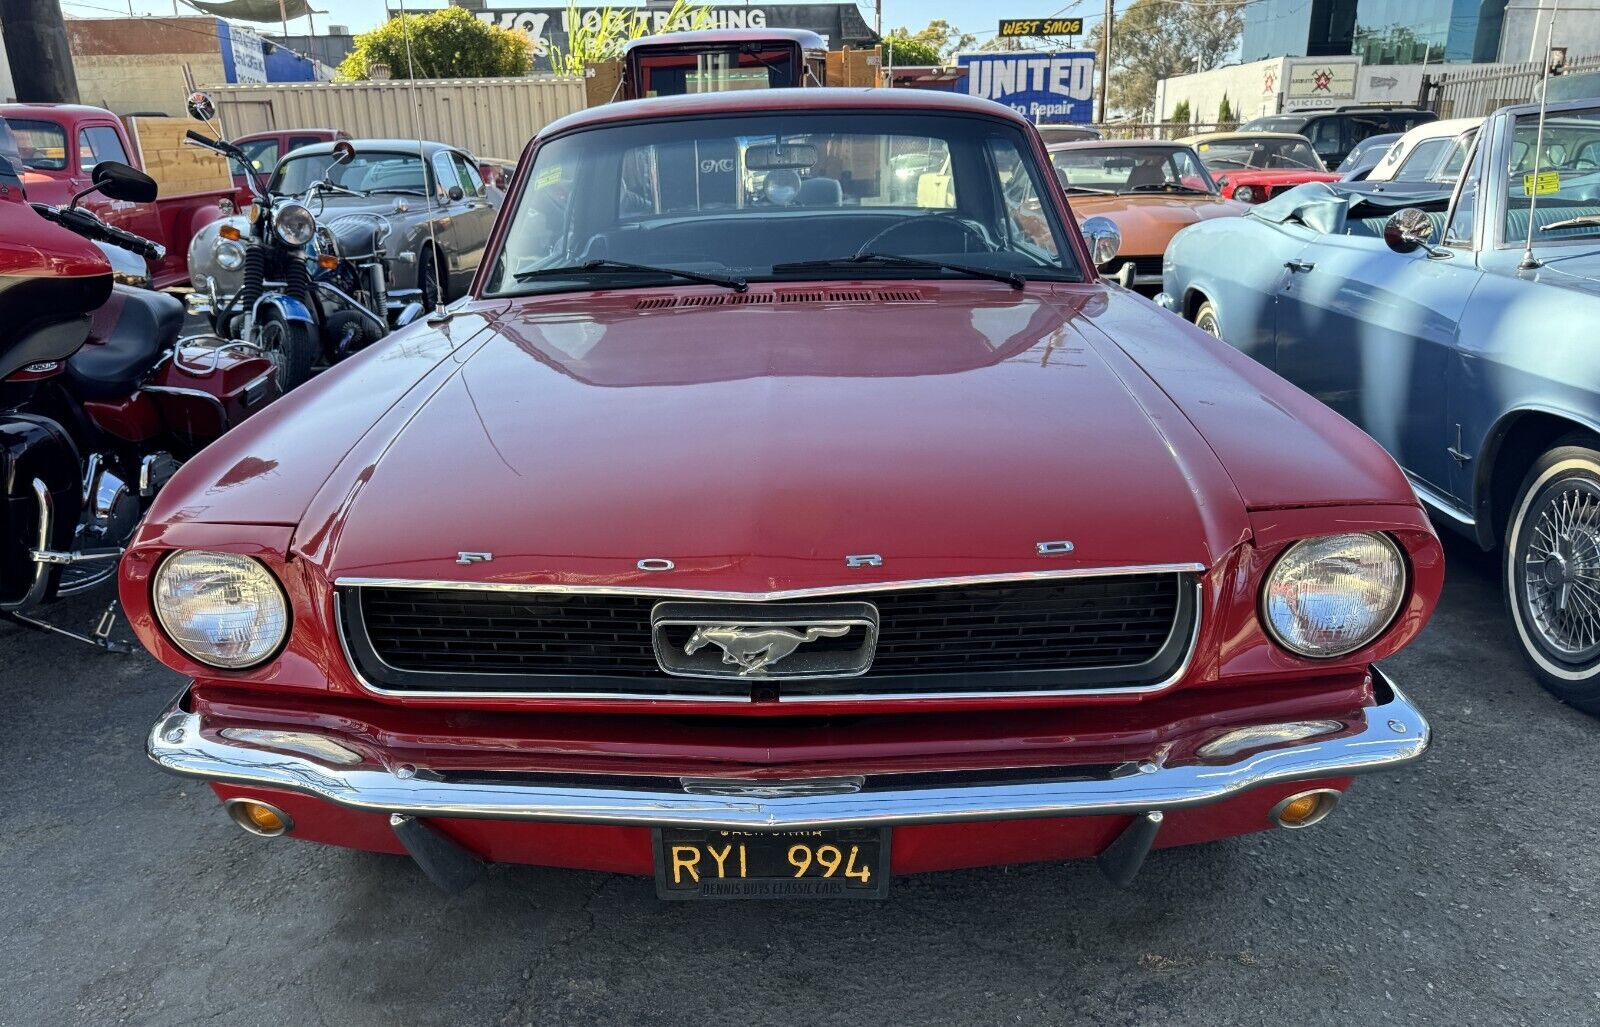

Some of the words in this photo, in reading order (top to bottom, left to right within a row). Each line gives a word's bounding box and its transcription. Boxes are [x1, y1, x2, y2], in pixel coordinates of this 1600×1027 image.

[1003, 21, 1040, 35] WEST
[1043, 20, 1080, 34] SMOG
[969, 57, 1095, 101] UNITED
[1030, 100, 1075, 117] Repair
[1288, 99, 1333, 107] AIKIDO
[701, 159, 734, 173] GMC
[672, 844, 746, 882] RYI
[787, 844, 871, 882] 994
[703, 882, 740, 897] DENNIS
[743, 882, 770, 897] BUYS
[772, 882, 815, 897] CLASSIC
[816, 882, 843, 896] CARS
